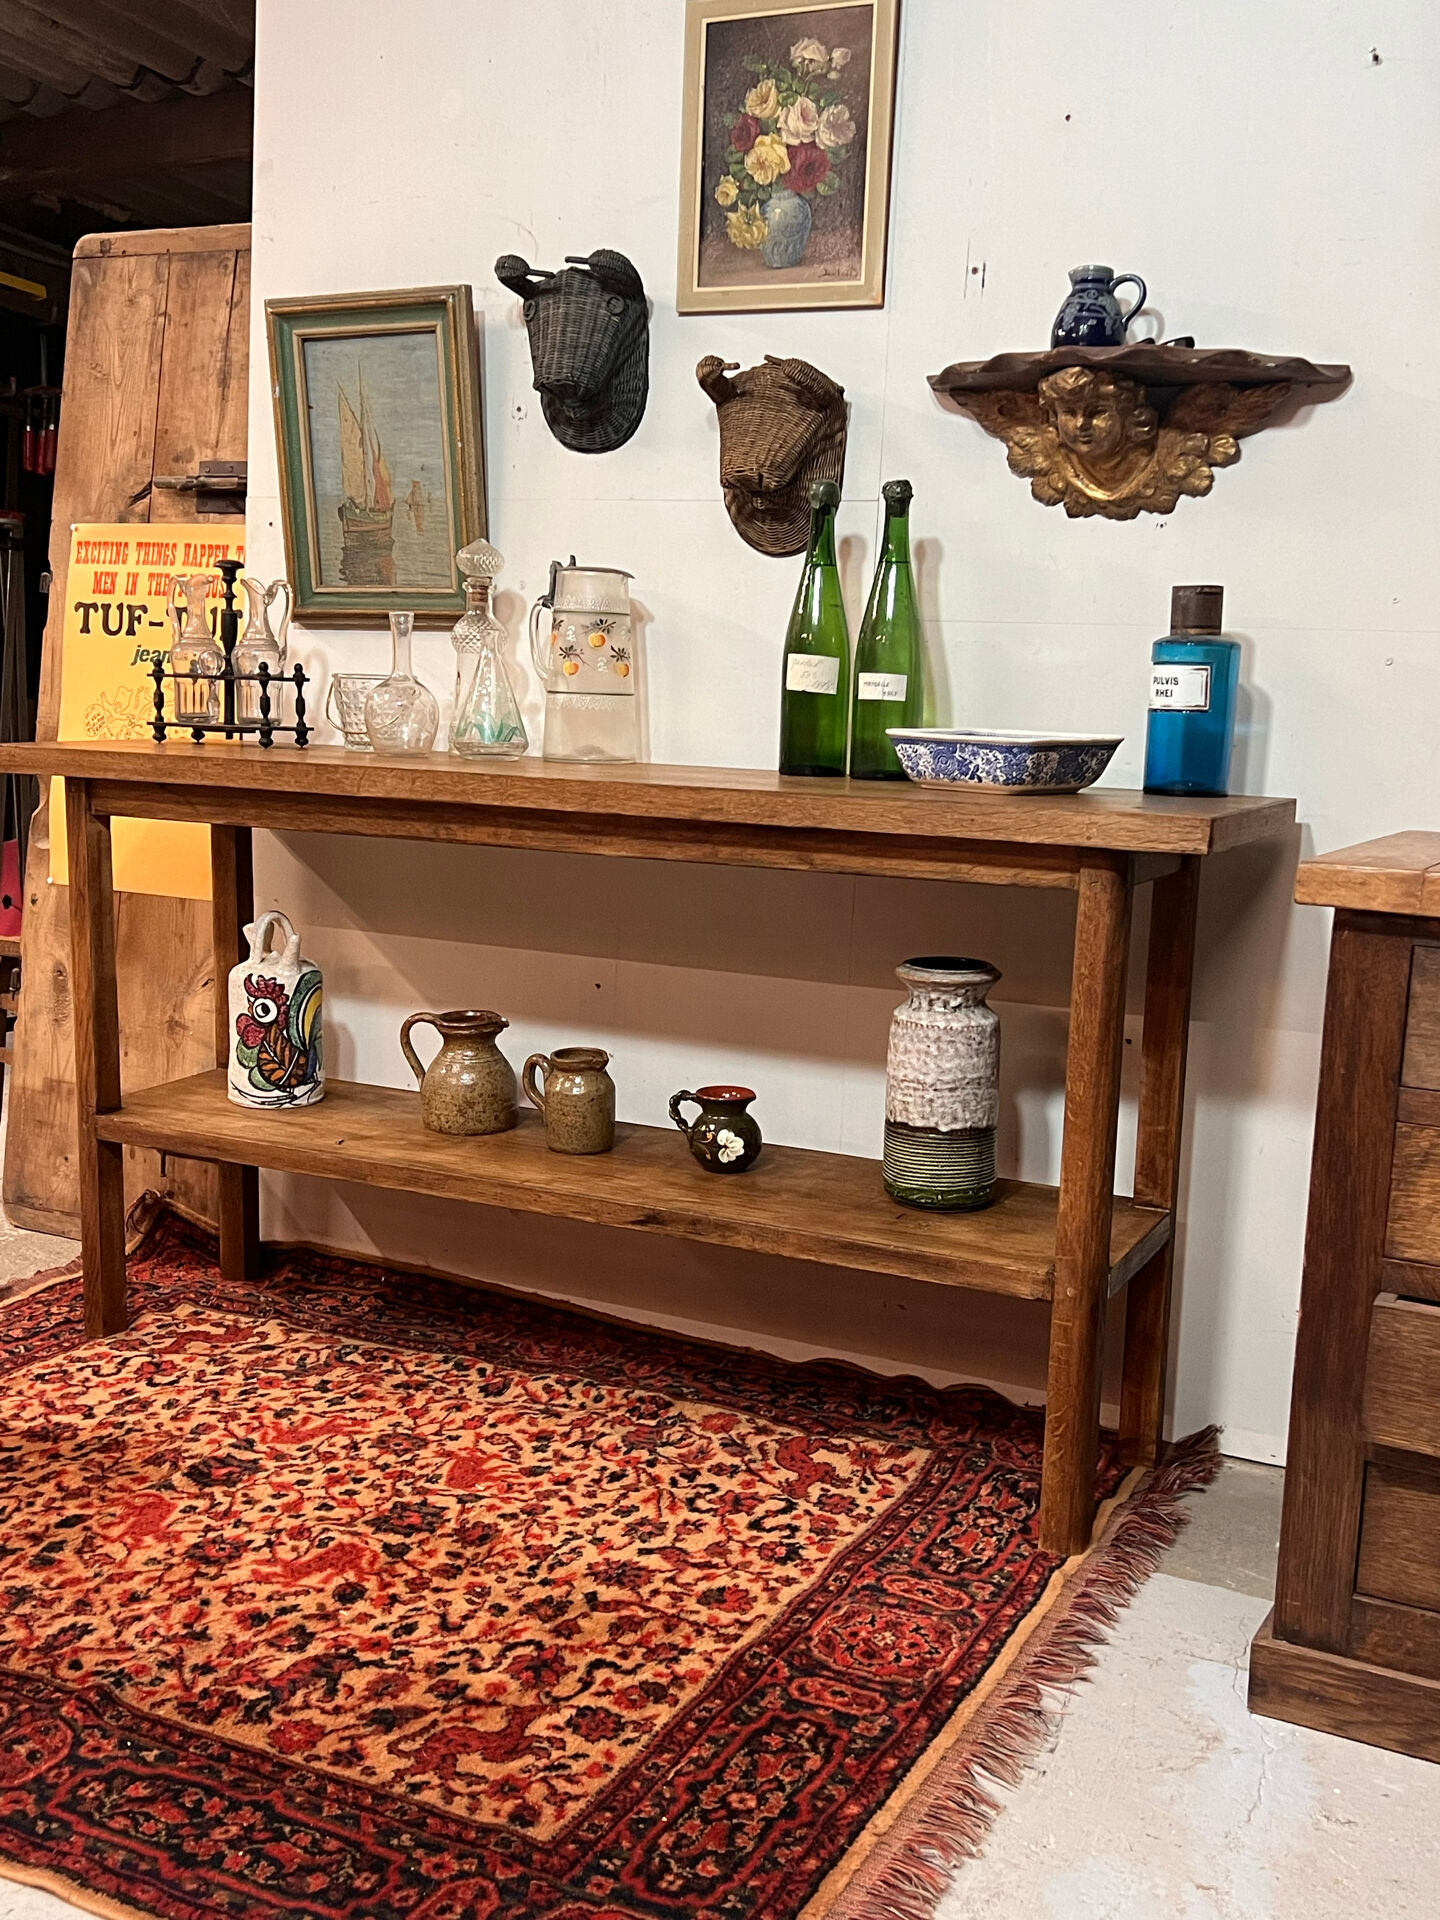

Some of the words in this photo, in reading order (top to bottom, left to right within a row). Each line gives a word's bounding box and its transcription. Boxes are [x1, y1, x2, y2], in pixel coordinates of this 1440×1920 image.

[75, 541, 129, 565] EXCITING
[136, 542, 178, 566] THINGS
[182, 543, 229, 568] HAPPEN
[92, 571, 118, 595] MEN
[125, 572, 139, 596] IN
[148, 573, 171, 597] THE
[1153, 676, 1179, 686] PULVIS
